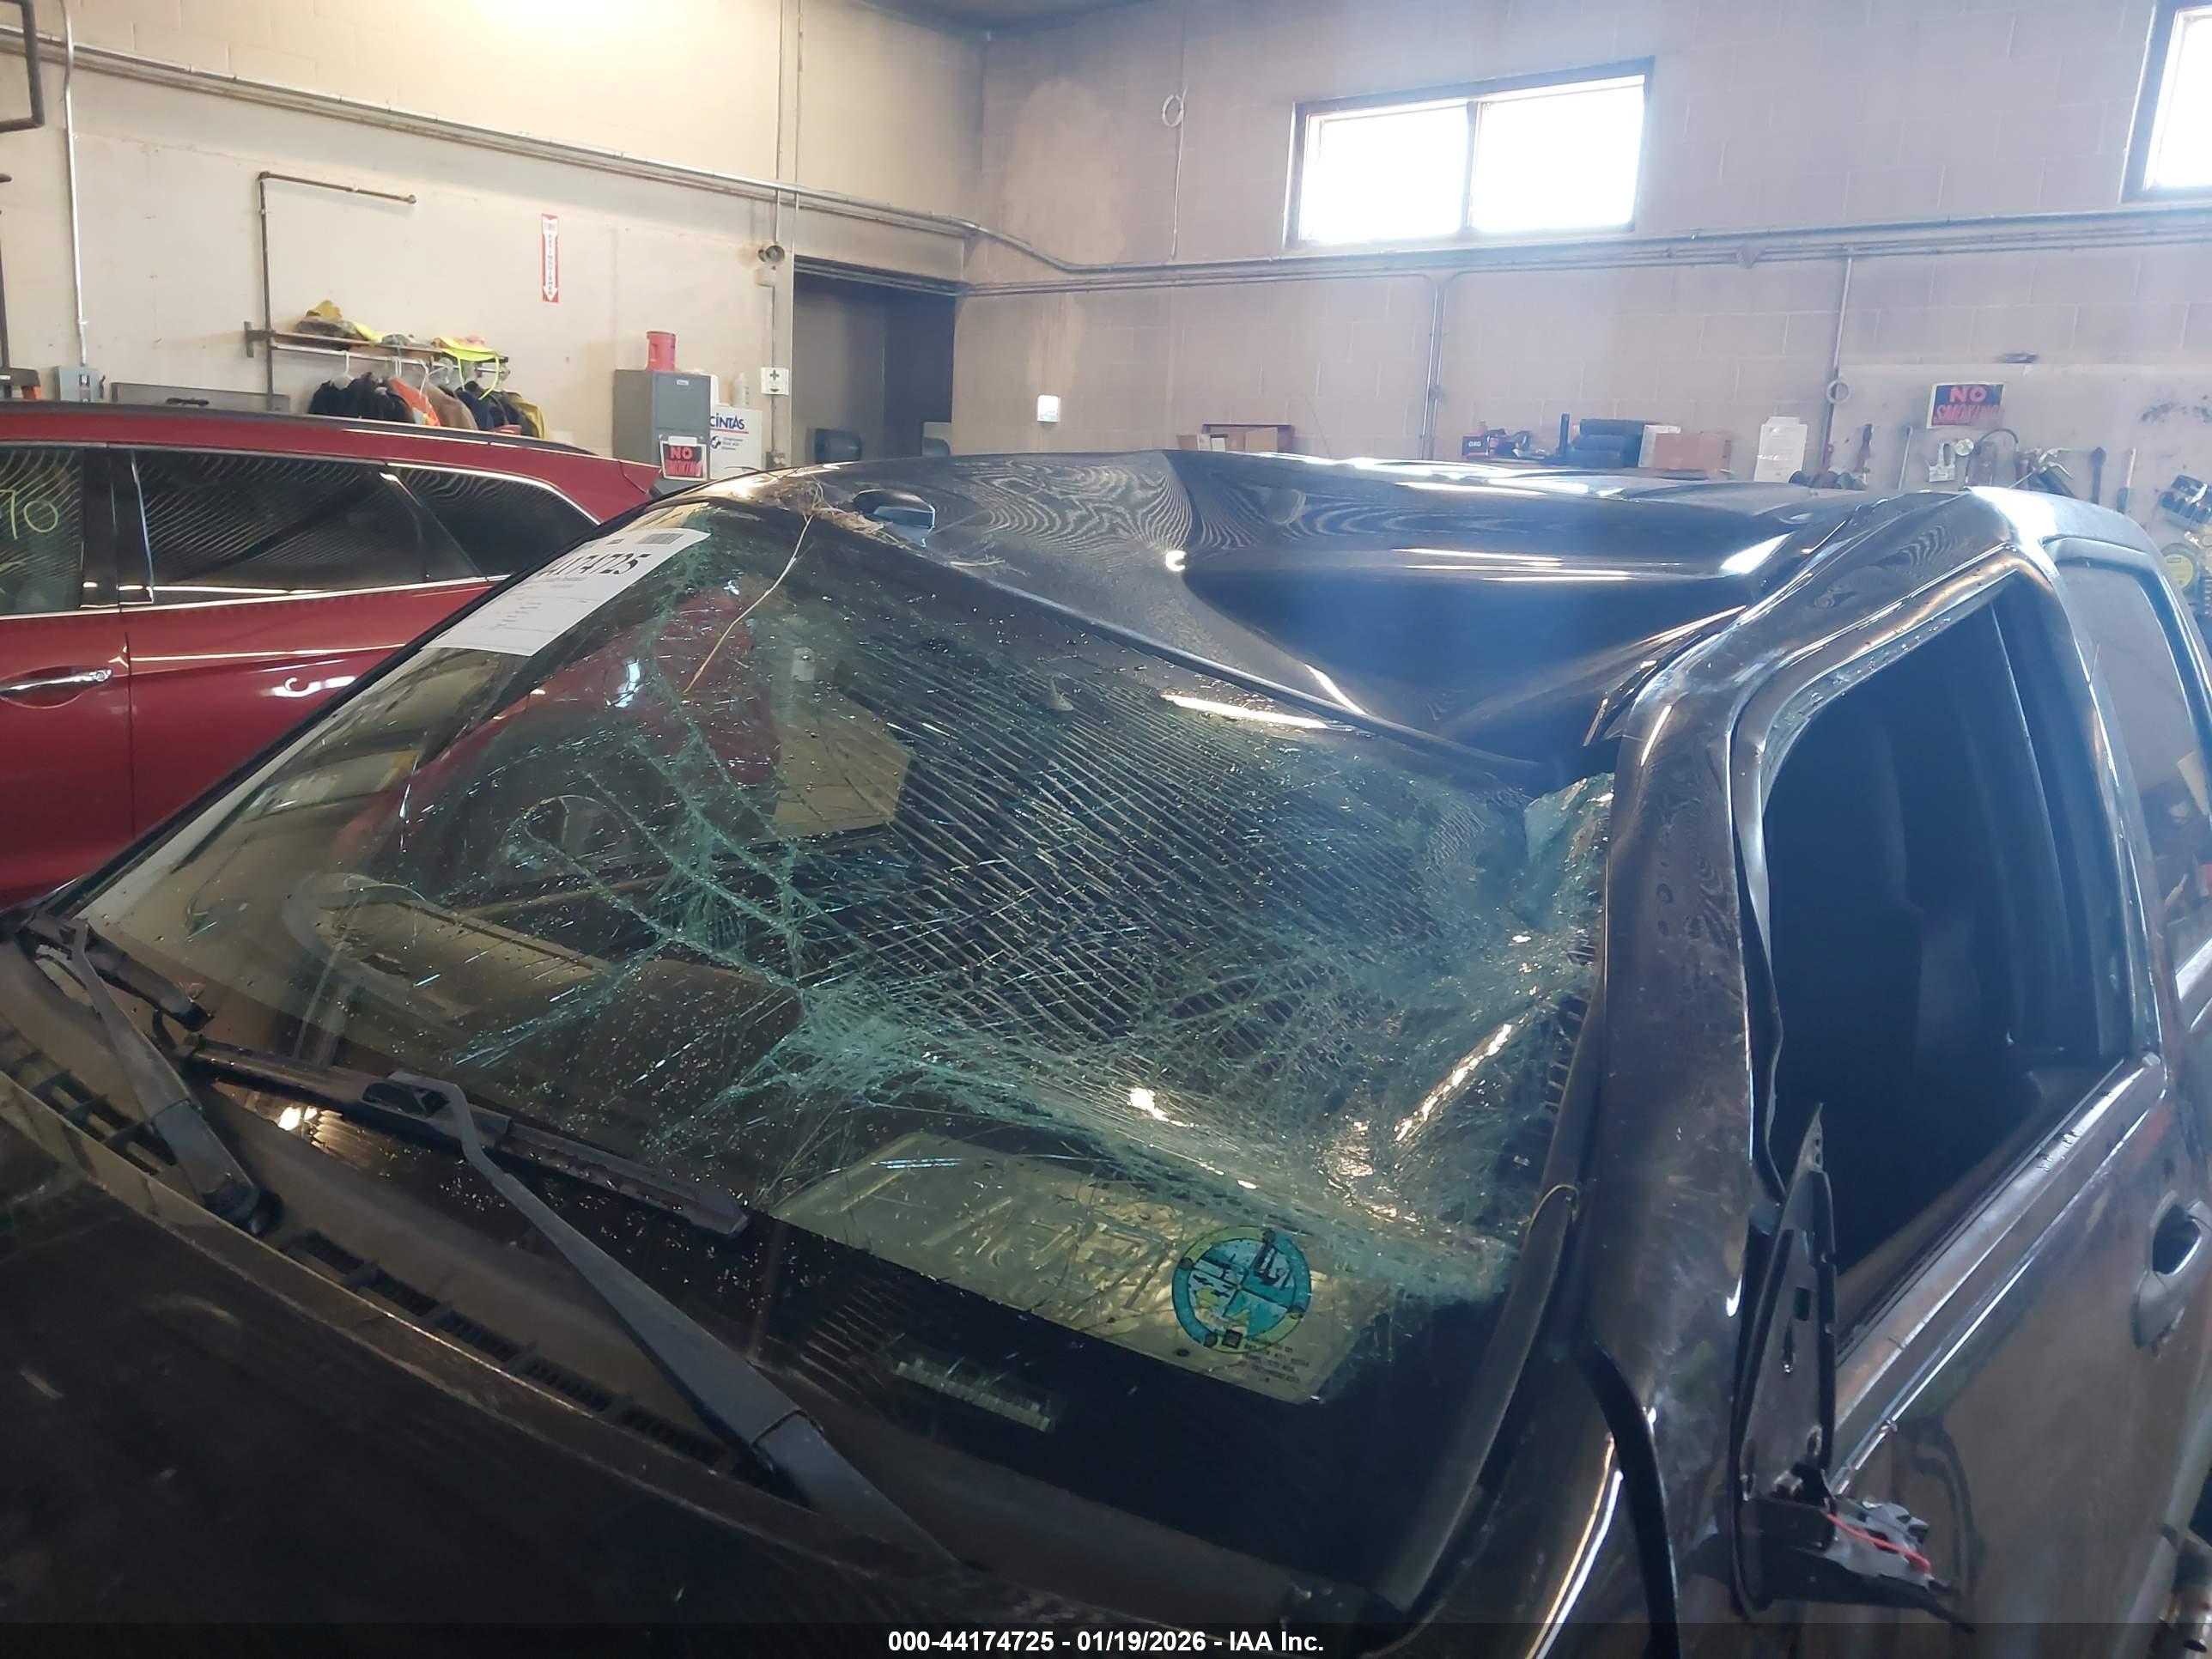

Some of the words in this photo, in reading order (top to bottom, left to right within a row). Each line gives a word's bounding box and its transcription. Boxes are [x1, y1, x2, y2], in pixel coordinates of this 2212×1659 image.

[1949, 386, 1987, 403] NO
[708, 412, 745, 431] CINTAS
[670, 446, 693, 460] NO
